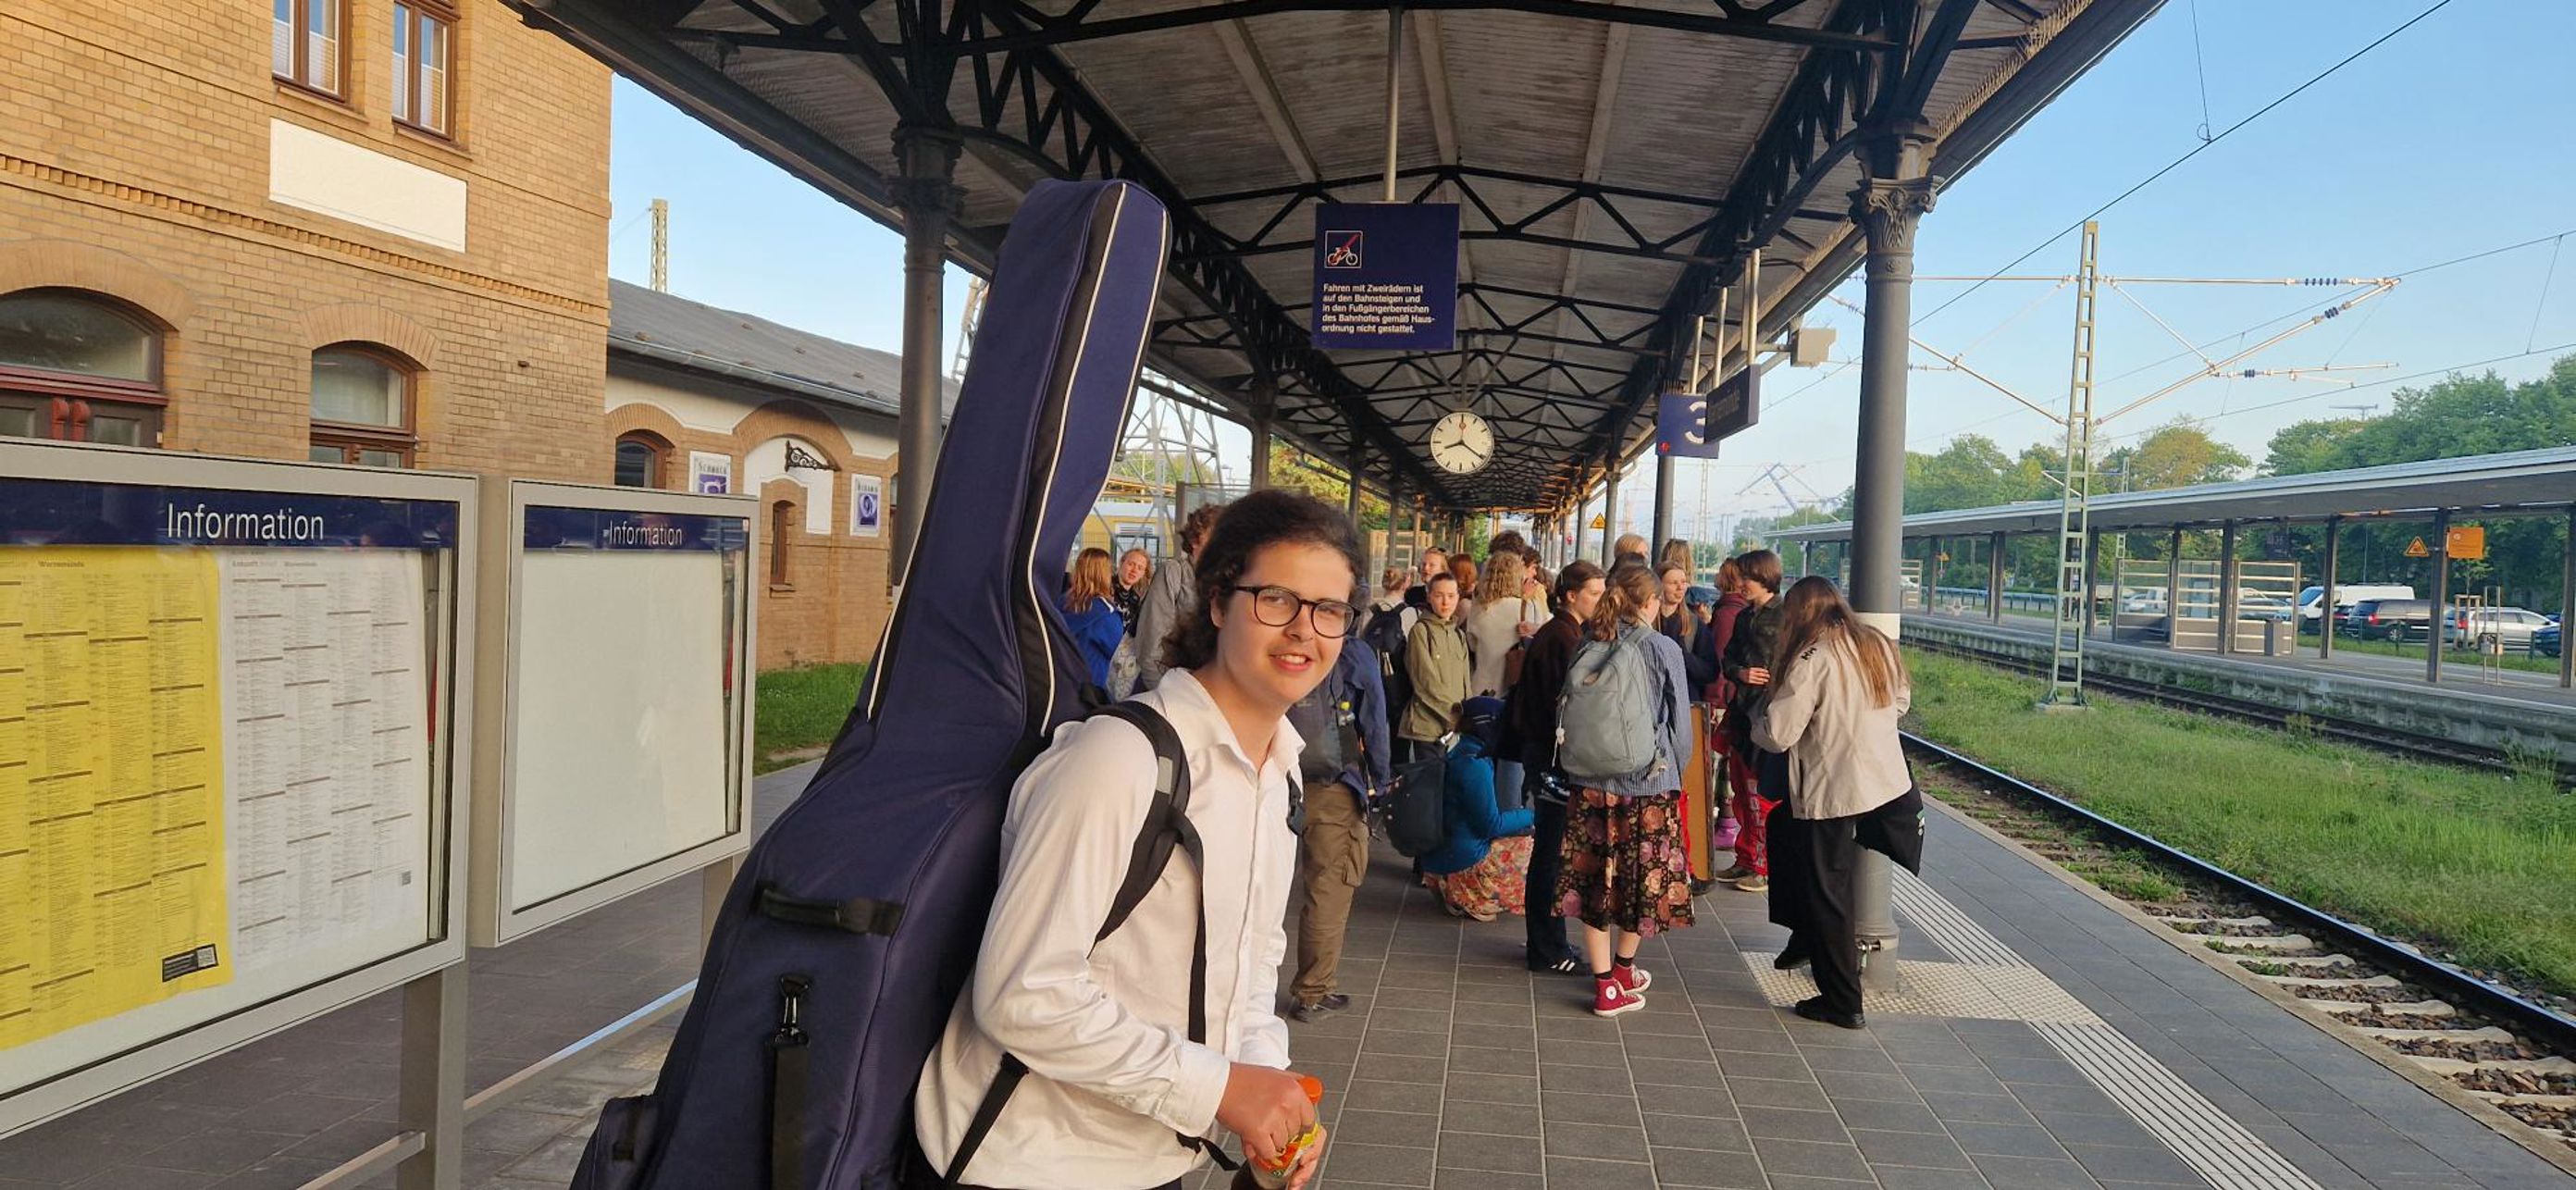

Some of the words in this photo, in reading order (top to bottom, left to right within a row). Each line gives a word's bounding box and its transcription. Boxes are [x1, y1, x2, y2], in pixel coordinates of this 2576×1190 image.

[1324, 283, 1351, 292] Fahren
[1352, 284, 1366, 292] mit
[1367, 284, 1412, 293] Zweirädern
[1413, 284, 1424, 293] ist
[1323, 294, 1336, 303] auf
[1337, 294, 1353, 303] den
[1355, 293, 1404, 304] Bahnsteigen
[1405, 294, 1421, 303] und
[1322, 304, 1331, 312] in
[1331, 304, 1347, 312] den
[1349, 304, 1430, 314] Fußgängerbereichen
[1322, 314, 1337, 322] des
[1339, 314, 1381, 322] Bahnhofes
[1381, 315, 1410, 324] gemäß
[1411, 315, 1435, 323] Haus-
[1321, 324, 1355, 334] ordnung
[1356, 324, 1377, 332] nicht
[1378, 324, 1416, 334] gestattet.
[1685, 401, 1707, 444] 3
[167, 502, 324, 540] Information
[610, 520, 682, 546] Information
